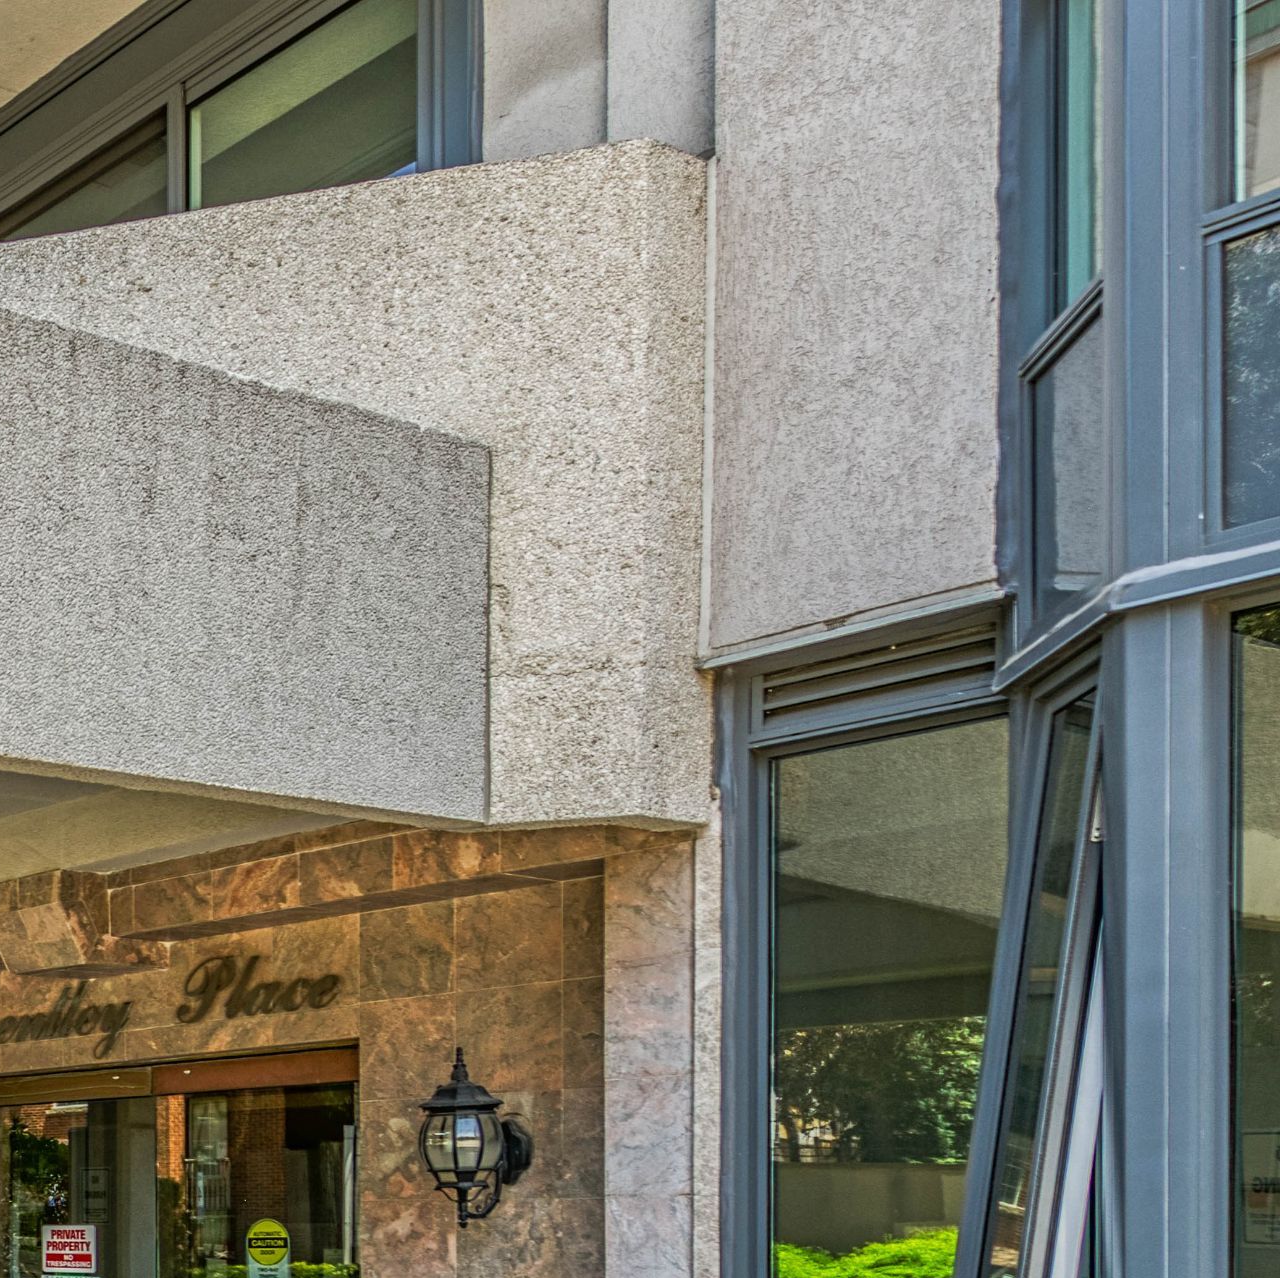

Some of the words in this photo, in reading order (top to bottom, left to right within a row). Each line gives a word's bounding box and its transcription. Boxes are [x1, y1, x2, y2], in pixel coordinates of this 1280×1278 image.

[176, 954, 343, 1024] Place
[50, 1229, 86, 1240] PRIVATE
[46, 1241, 91, 1251] PROPERTY
[251, 1239, 285, 1247] CAUTION
[46, 1260, 92, 1268] TRESPASSING
